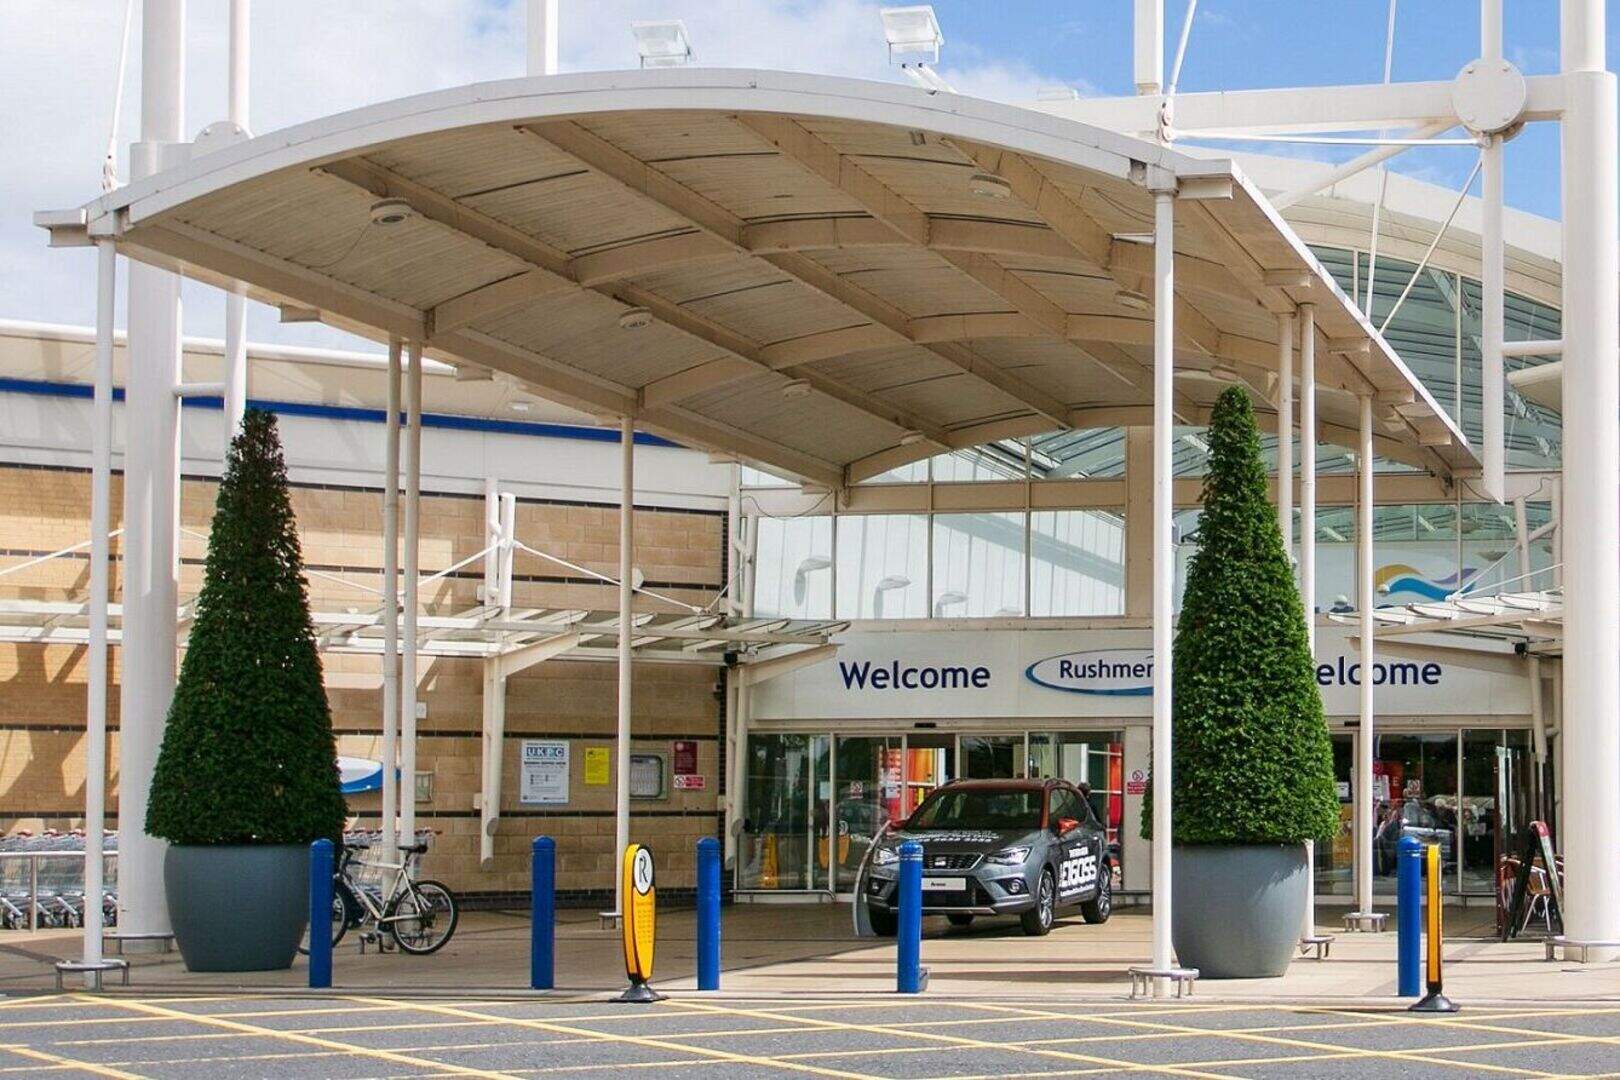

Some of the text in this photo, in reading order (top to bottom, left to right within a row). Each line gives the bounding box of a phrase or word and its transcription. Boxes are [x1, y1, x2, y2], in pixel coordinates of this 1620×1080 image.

[839, 660, 991, 690] Welcome
[1060, 660, 1154, 679] Rushmer
[1316, 656, 1442, 685] elcome
[638, 855, 648, 883] R
